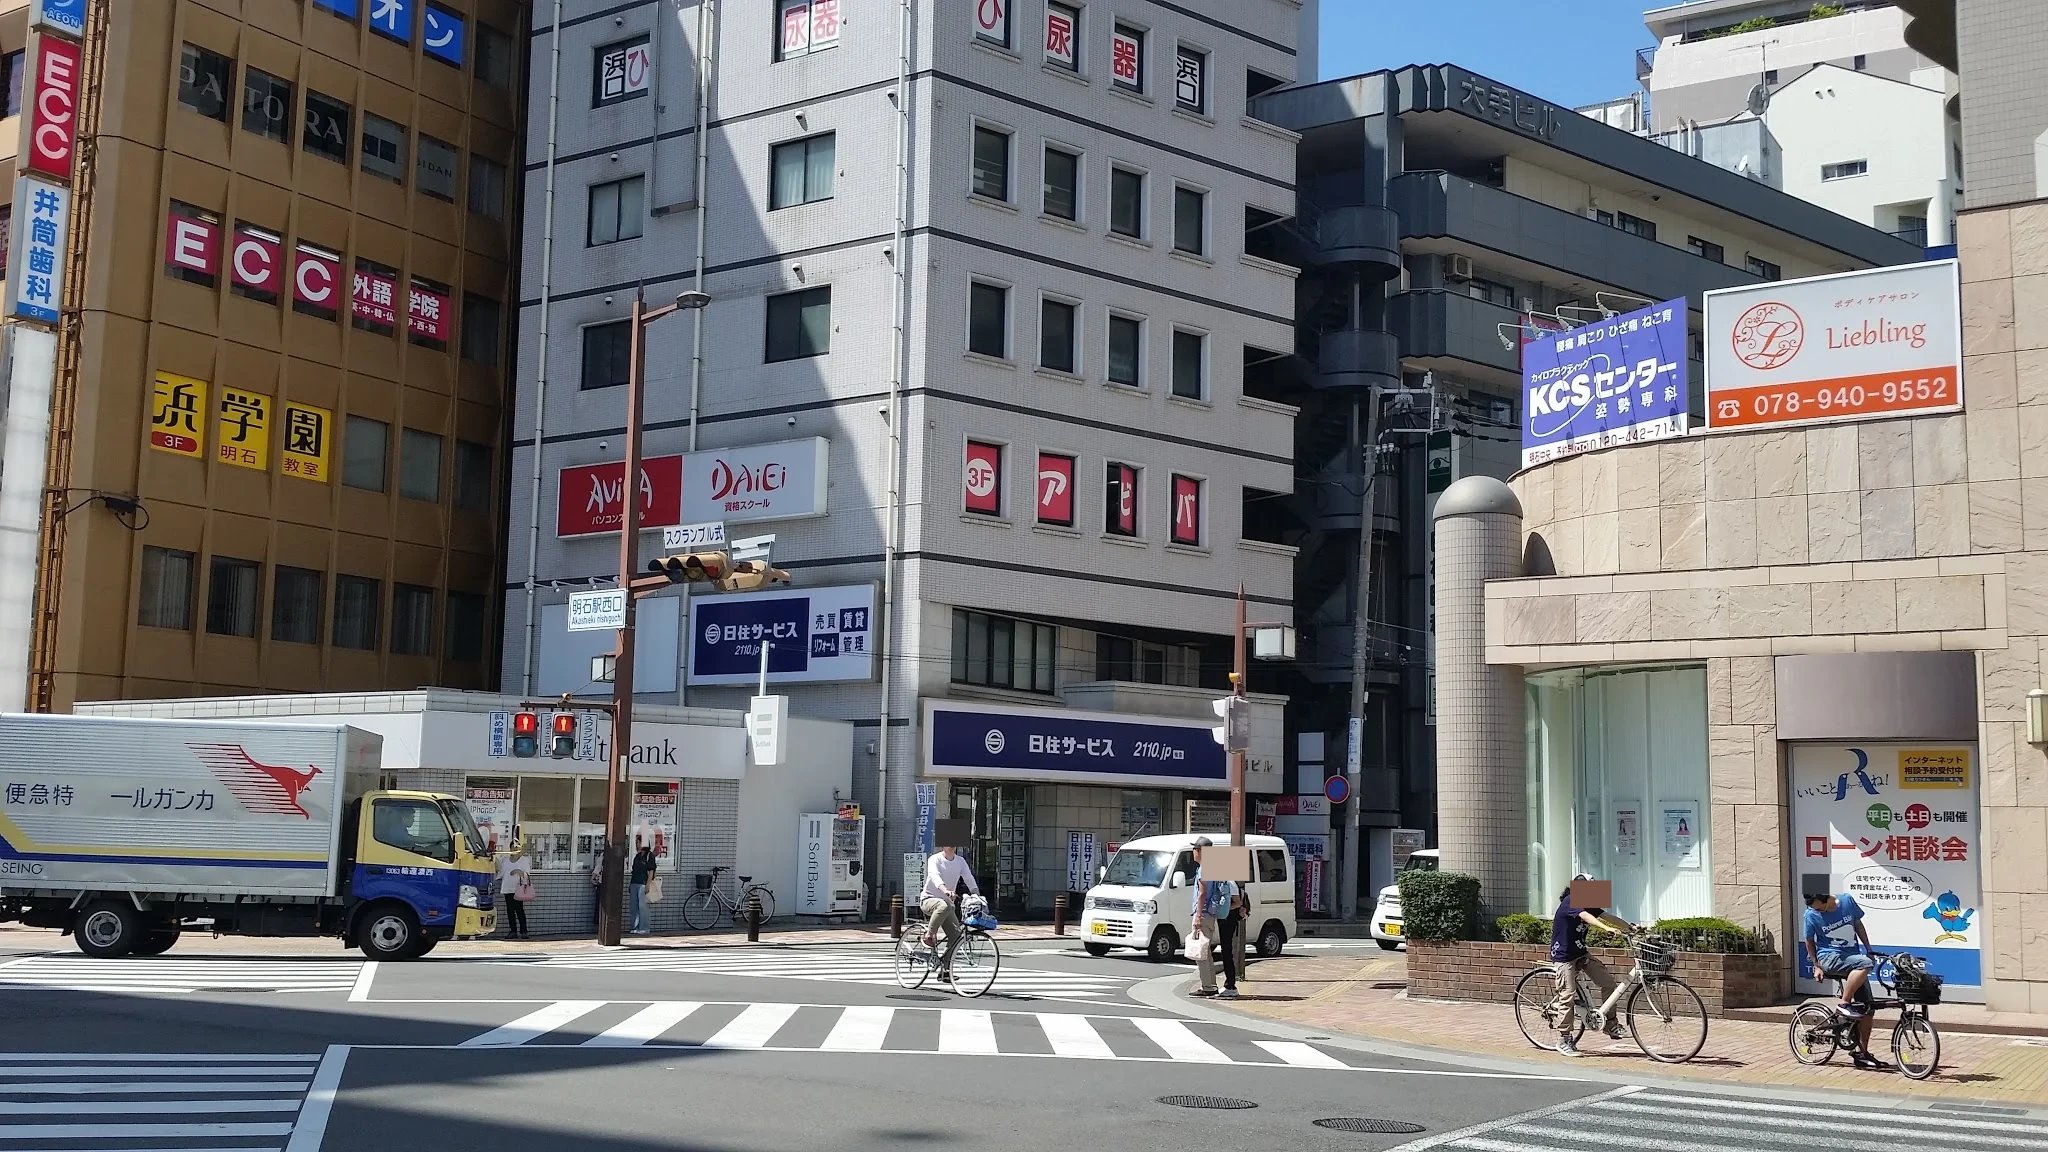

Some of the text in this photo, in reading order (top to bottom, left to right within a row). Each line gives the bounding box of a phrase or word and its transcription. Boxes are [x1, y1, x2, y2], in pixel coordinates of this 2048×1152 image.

[46, 8, 80, 28] AEON
[35, 51, 73, 160] ECC
[1460, 77, 1560, 139] 大手ビル
[26, 188, 60, 305] 井筒歯科
[1834, 291, 1920, 309] ボディケアサロン
[1577, 327, 1605, 348] 肩こり
[1608, 318, 1639, 338] ひざ痛
[1641, 308, 1673, 330] ねこ背
[1826, 317, 1927, 349] Liebling
[1754, 376, 1948, 417] 078-940-9552
[164, 434, 183, 449] 3F
[967, 467, 992, 488] 3F
[724, 499, 771, 513] 資格スクール
[665, 525, 724, 546] スクランブル式
[572, 596, 622, 615] 明石駅西口
[815, 612, 836, 630] 売買
[843, 611, 865, 629] 賃貸
[723, 621, 798, 641] 日住サービス
[843, 635, 864, 653] 管理
[1029, 734, 1115, 758] 日住サービス
[1133, 741, 1172, 761] 2110.jp
[1904, 756, 1963, 764] インターネット
[1904, 766, 1964, 775] 相談予約受付中
[1805, 835, 1969, 862] ローン相談会
[1068, 832, 1079, 891] 日住サービス
[806, 842, 820, 906] SoftBank
[1855, 875, 1915, 883] 住宅やマイカー購入
